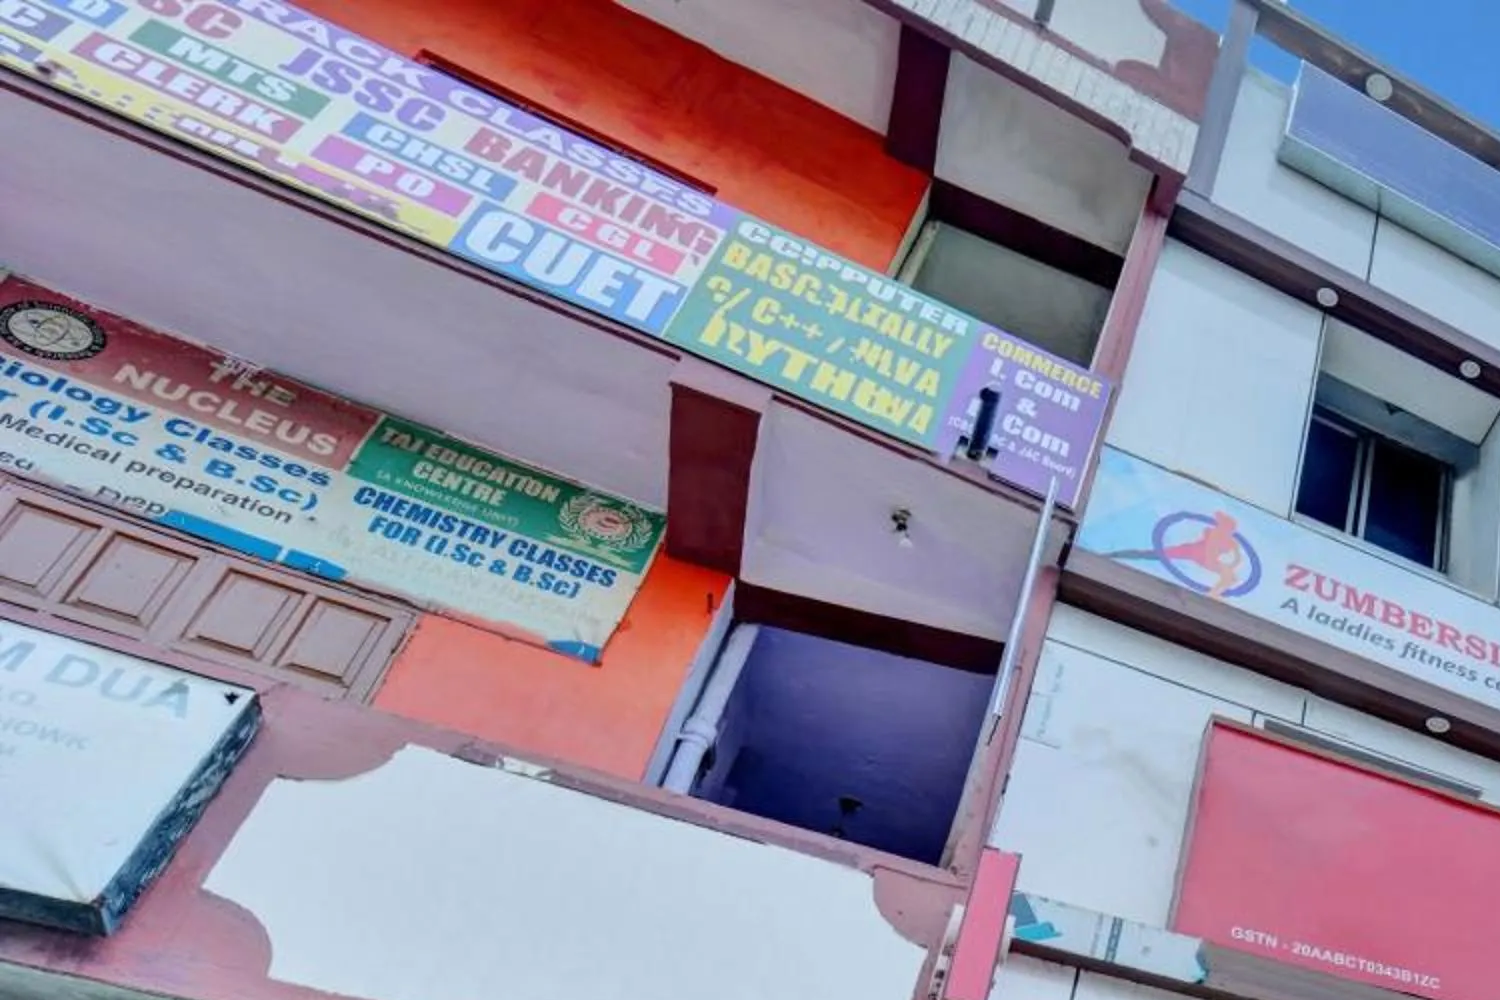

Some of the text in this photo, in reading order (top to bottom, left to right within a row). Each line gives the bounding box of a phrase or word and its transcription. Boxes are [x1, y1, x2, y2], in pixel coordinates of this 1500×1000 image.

[92, 42, 286, 136] CLERK
[167, 36, 298, 102] MTS
[277, 47, 447, 132] JSSC
[365, 123, 496, 194] CHSL
[448, 89, 714, 217] CLASSES
[465, 210, 681, 321] CUET
[982, 331, 1103, 399] COMMERCE
[111, 362, 338, 456] NUCLEUS
[155, 442, 188, 465] &
[163, 416, 333, 488] Classes
[411, 460, 507, 507] CENTRE
[424, 442, 562, 503] EDUCATION
[123, 457, 293, 525] preparation
[353, 485, 618, 589] CHEMISTRY CLASSES
[367, 514, 423, 547] FOR
[488, 558, 508, 577] &
[1280, 597, 1299, 616] A
[1307, 604, 1396, 651] laddies
[1399, 640, 1478, 682] fitness
[45, 652, 192, 719] DUA
[1231, 926, 1278, 948] GSTN
